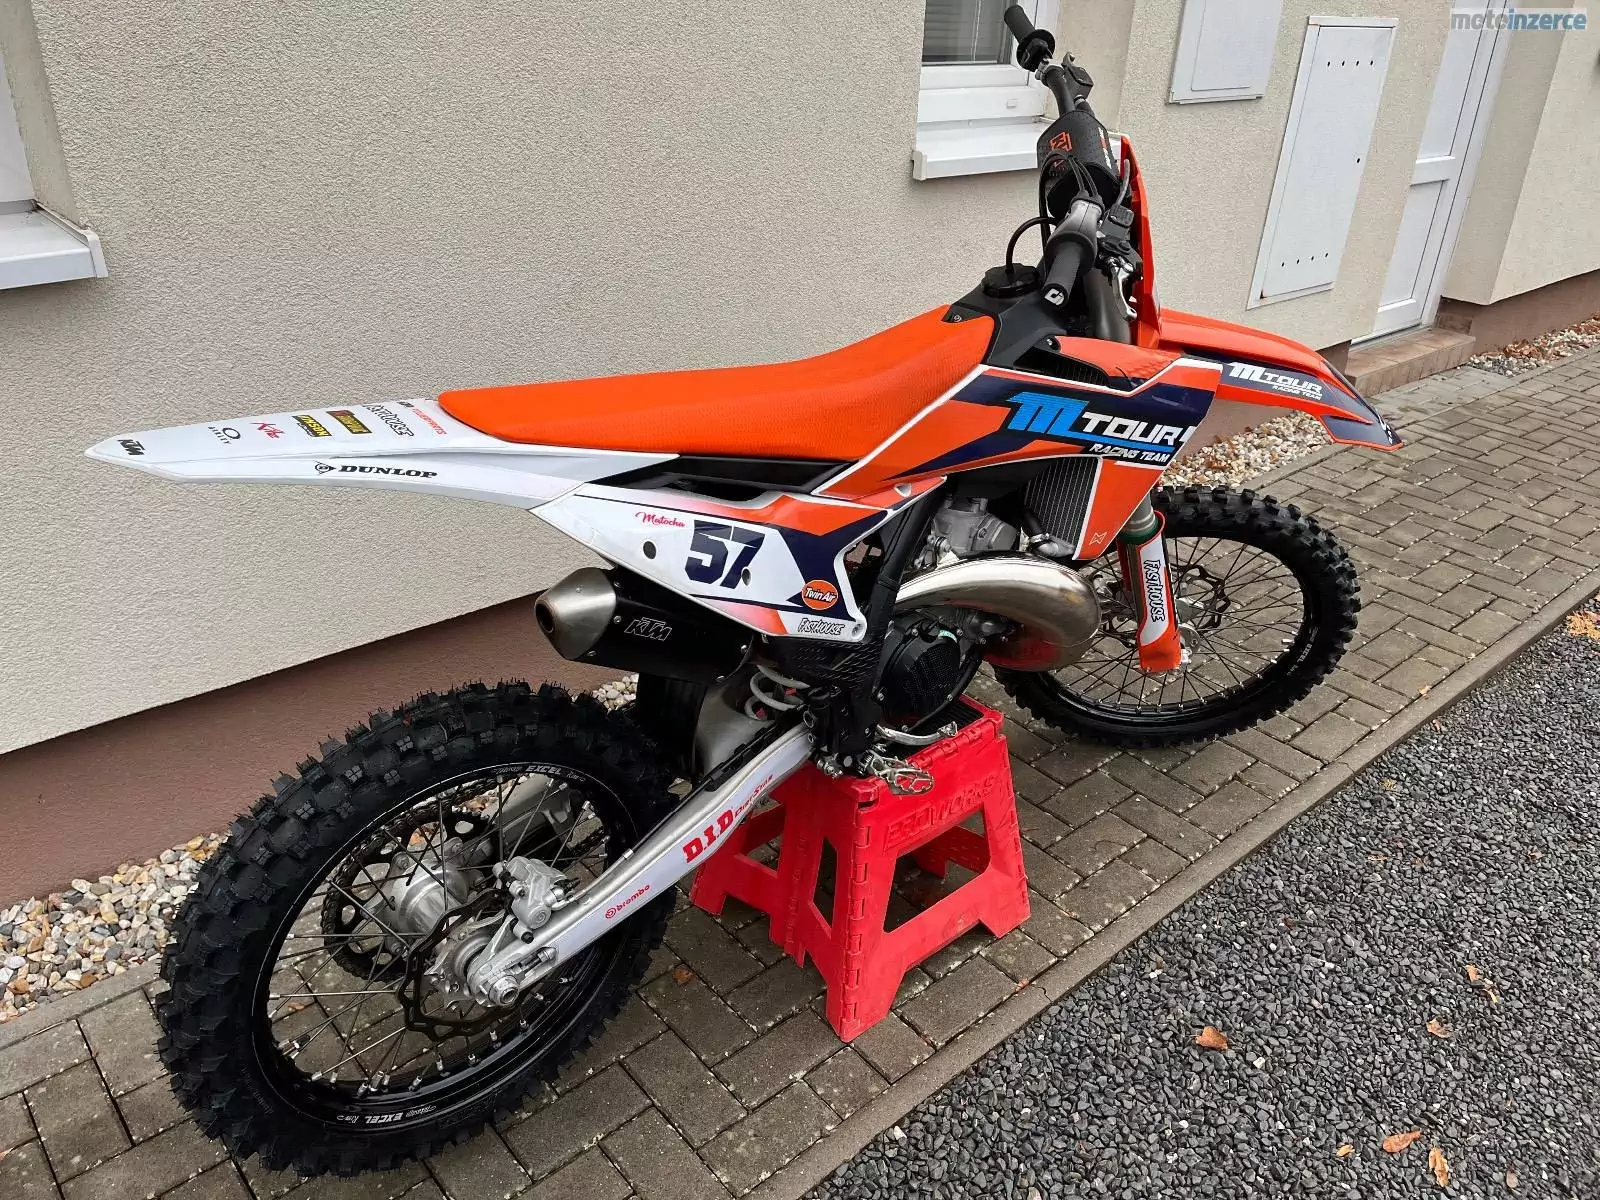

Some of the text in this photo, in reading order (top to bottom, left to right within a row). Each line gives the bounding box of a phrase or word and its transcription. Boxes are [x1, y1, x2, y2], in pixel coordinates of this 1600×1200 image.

[1302, 389, 1322, 400] TEAM
[116, 439, 146, 456] KTM
[1089, 443, 1171, 463] RACING TEAM
[338, 465, 438, 479] DUNLOP
[634, 511, 686, 528] Matocha
[684, 519, 766, 590] 57
[805, 587, 837, 603] Twin Air
[1143, 559, 1166, 623] FASTHOUSE
[624, 616, 673, 642] KTM
[797, 617, 846, 636] FASTHOUSE
[525, 765, 562, 775] EXCEL
[682, 809, 734, 863] D.I.D
[616, 884, 650, 911] brembo
[364, 1112, 404, 1124] EXCEL
